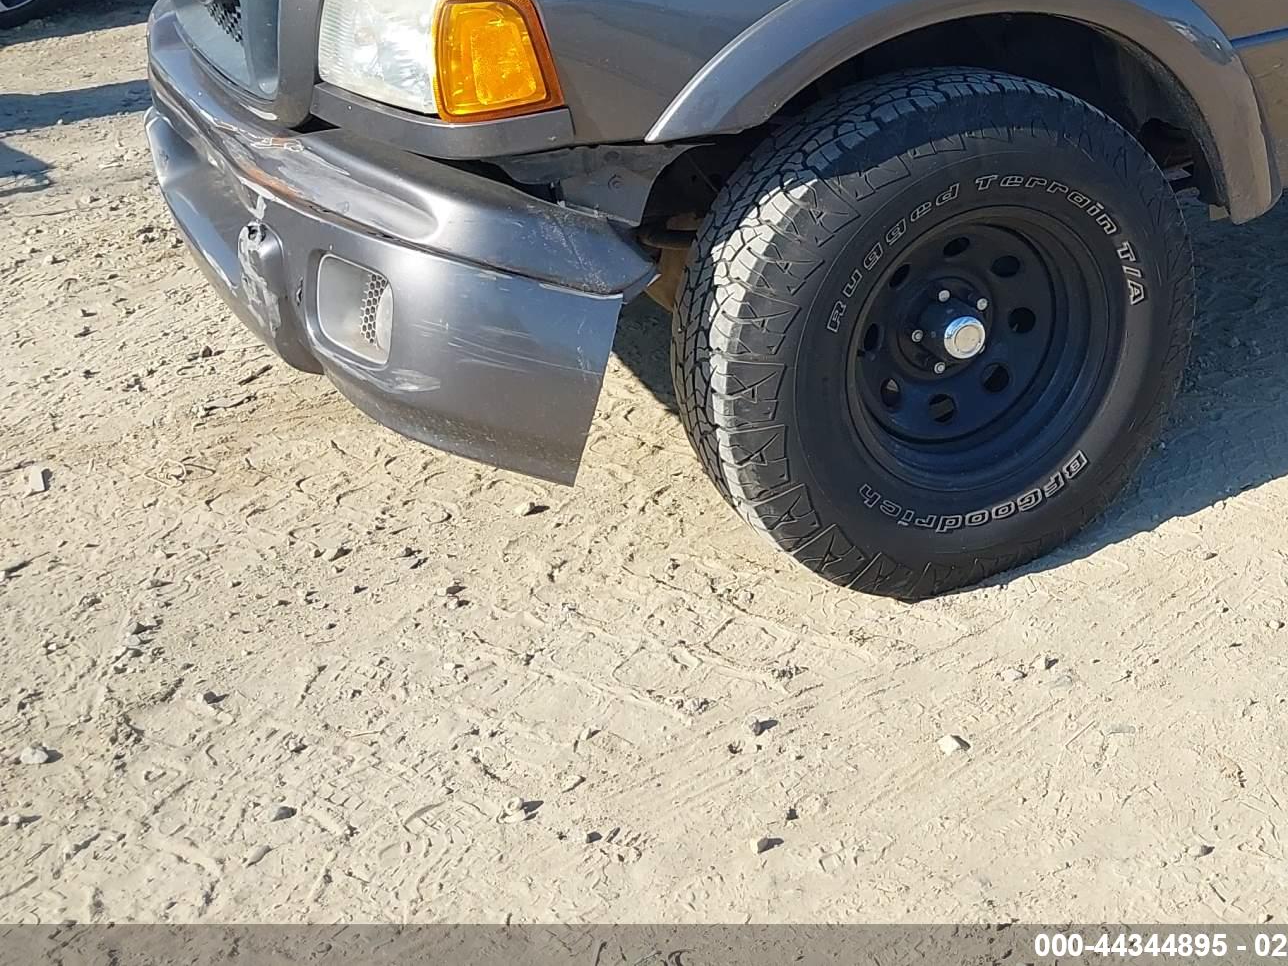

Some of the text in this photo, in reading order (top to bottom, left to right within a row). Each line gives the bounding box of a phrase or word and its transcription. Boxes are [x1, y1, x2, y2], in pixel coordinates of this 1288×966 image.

[827, 174, 1146, 333] Rugged Terrain T/A
[858, 449, 1090, 533] BFGoodrich
